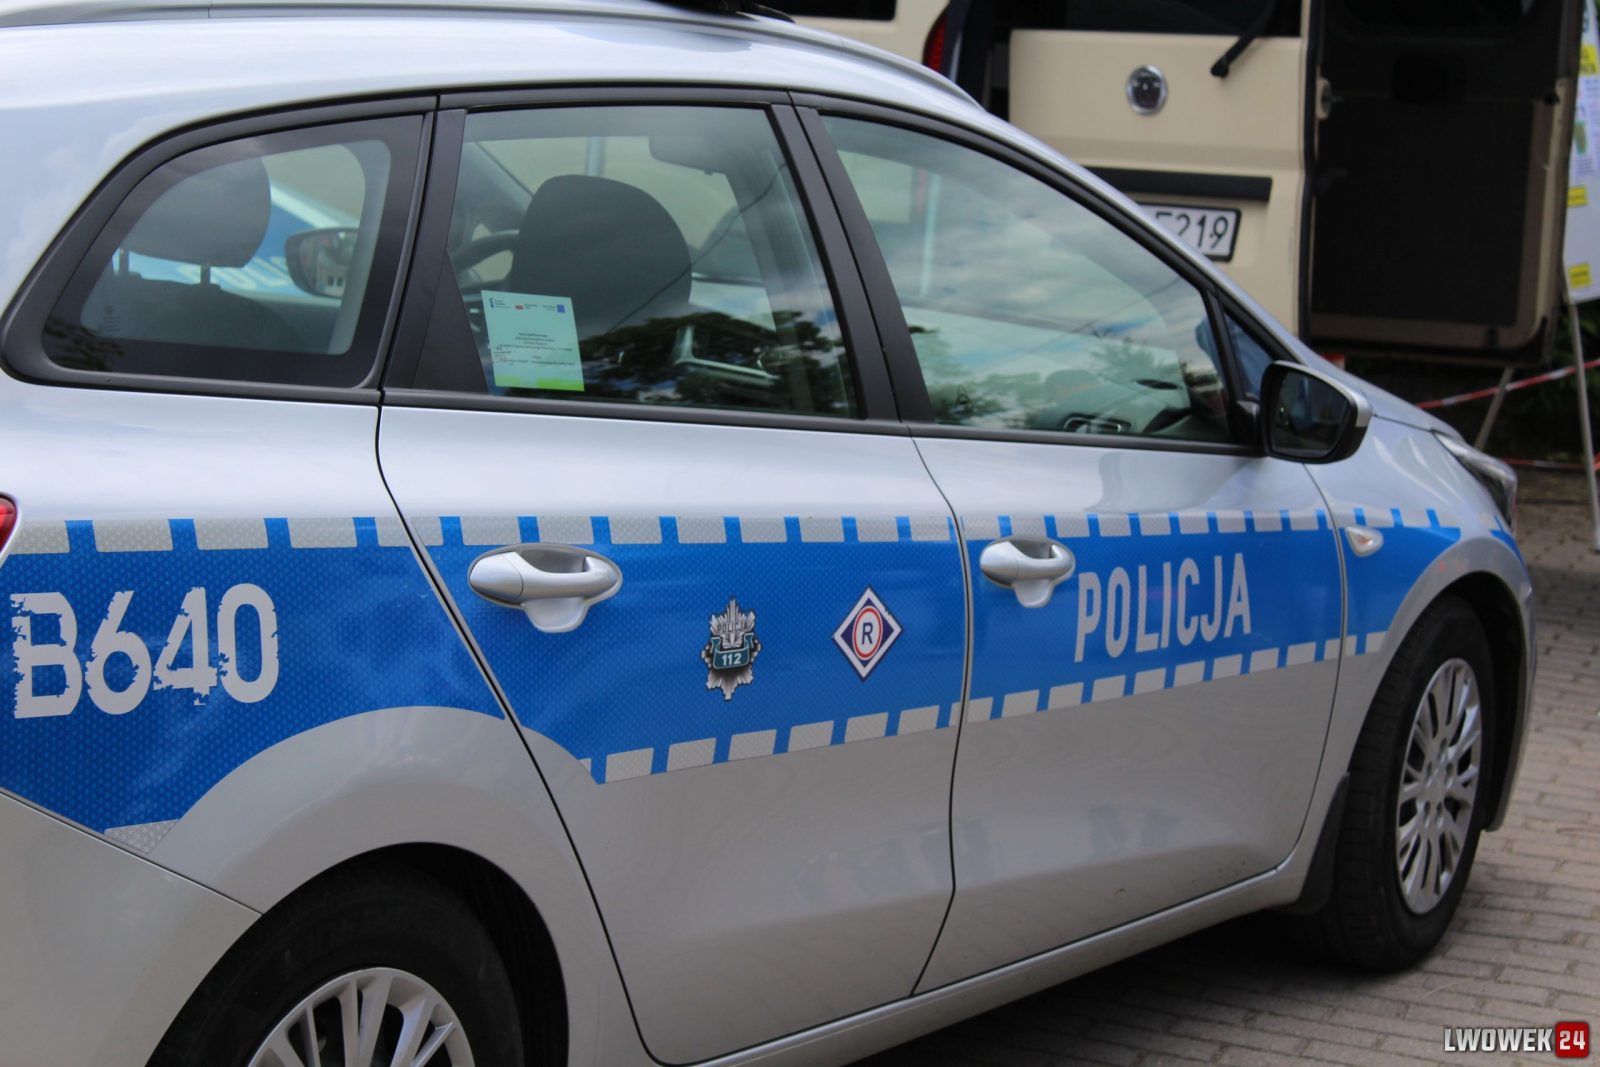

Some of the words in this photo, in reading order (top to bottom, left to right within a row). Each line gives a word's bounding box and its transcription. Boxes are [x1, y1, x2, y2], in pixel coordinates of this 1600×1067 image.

[1074, 552, 1251, 662] POLICJA
[717, 622, 749, 633] POLICJA
[861, 622, 873, 645] R
[10, 583, 279, 719] B640
[721, 652, 742, 666] 112
